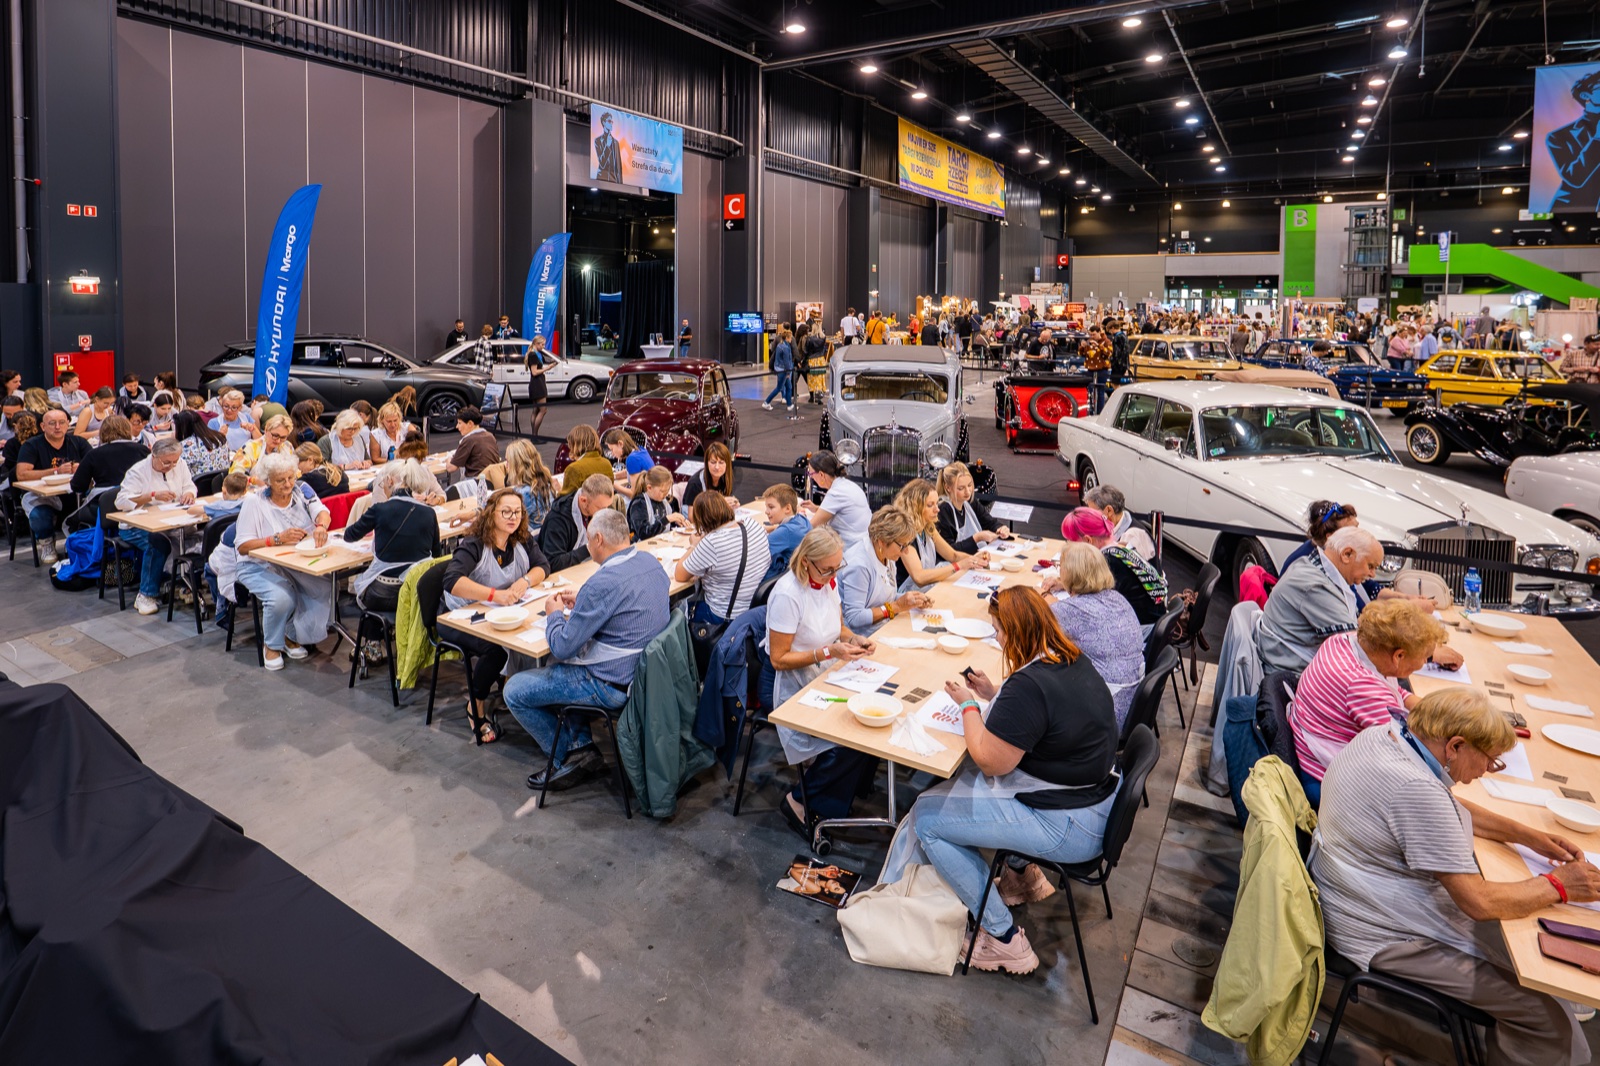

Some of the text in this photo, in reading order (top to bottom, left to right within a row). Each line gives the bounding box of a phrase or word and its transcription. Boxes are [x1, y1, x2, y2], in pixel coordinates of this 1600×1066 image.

[631, 142, 658, 157] Warsztaty
[947, 145, 969, 170] TARGI
[631, 160, 673, 175] Strefa dla dzieci
[916, 165, 934, 180] POLSCE
[728, 197, 741, 215] C
[1293, 208, 1309, 227] B
[1059, 255, 1067, 264] C
[268, 224, 297, 364] HYUNDAI Margo
[534, 254, 552, 334] HYUNDAI Margo
